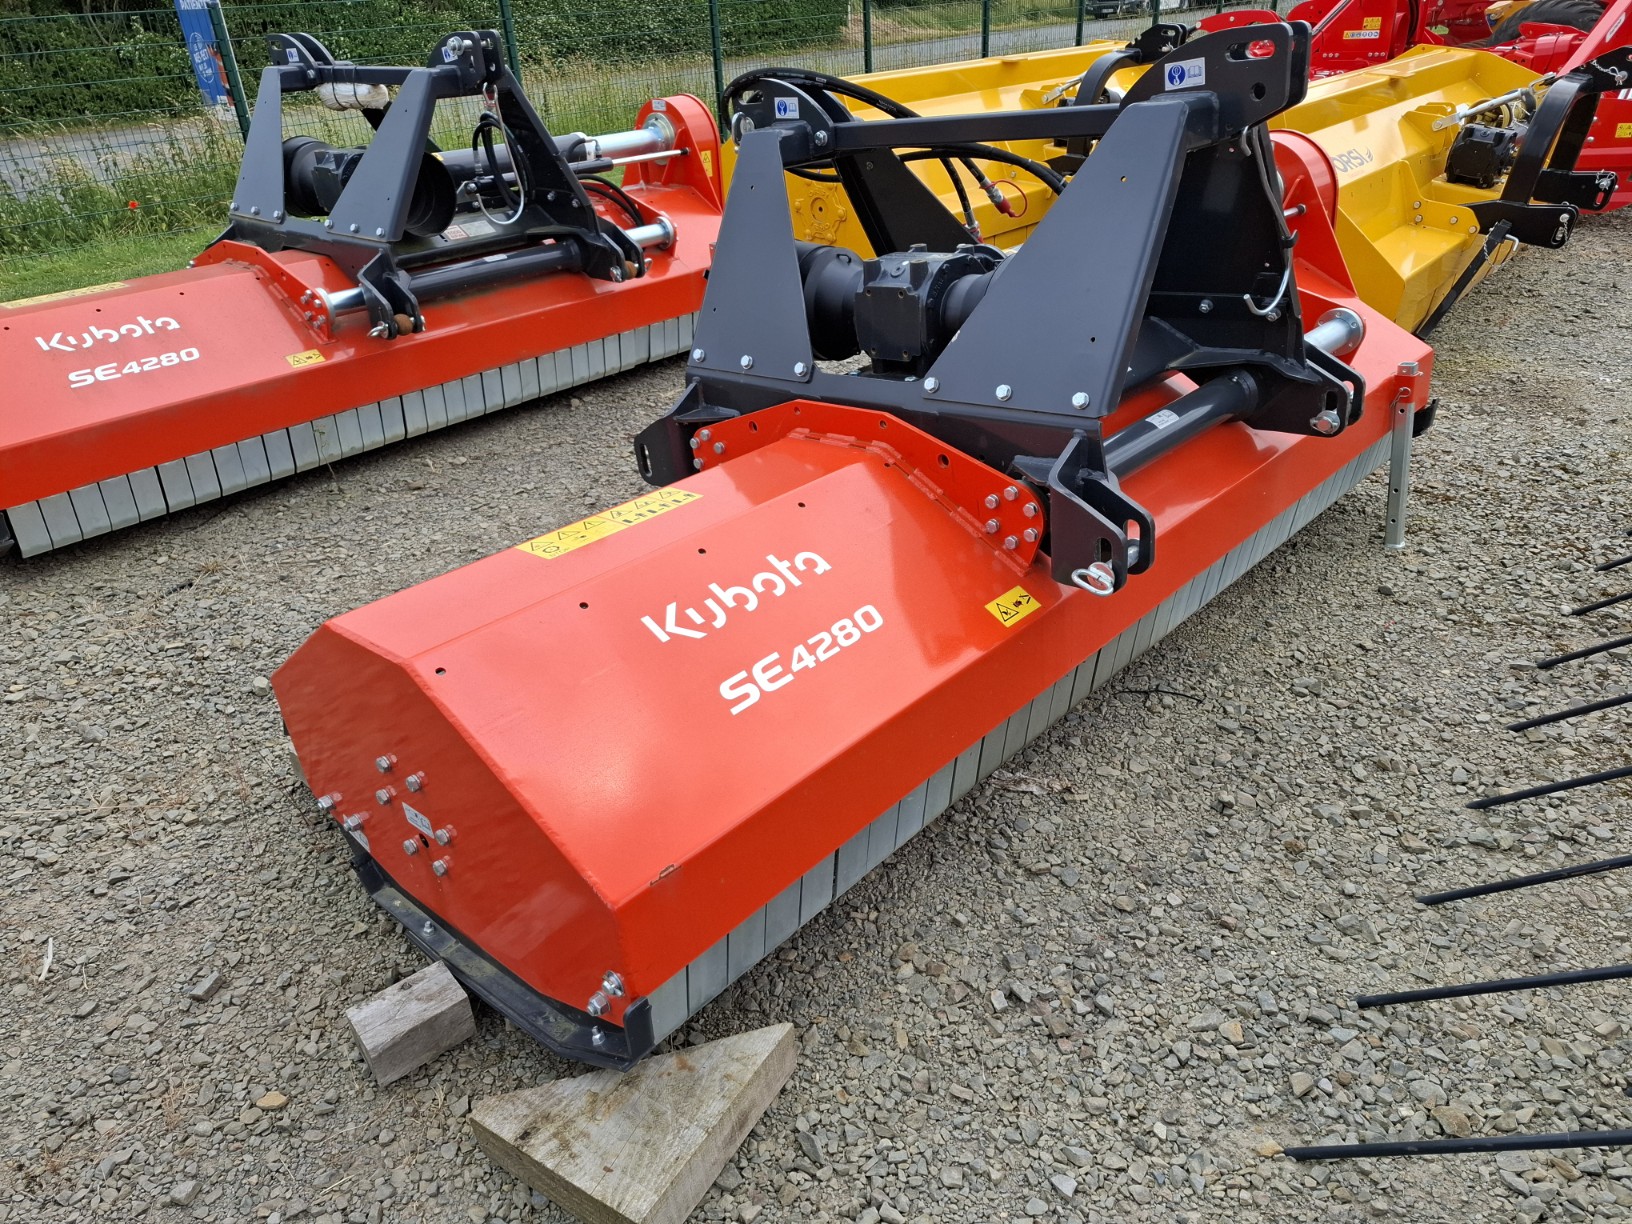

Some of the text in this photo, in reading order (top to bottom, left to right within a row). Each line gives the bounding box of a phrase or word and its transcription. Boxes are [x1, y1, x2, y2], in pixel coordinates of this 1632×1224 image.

[35, 316, 181, 351] Kubota
[68, 347, 200, 388] SE4280
[640, 551, 832, 643] Kubota
[719, 604, 884, 716] SE4280
